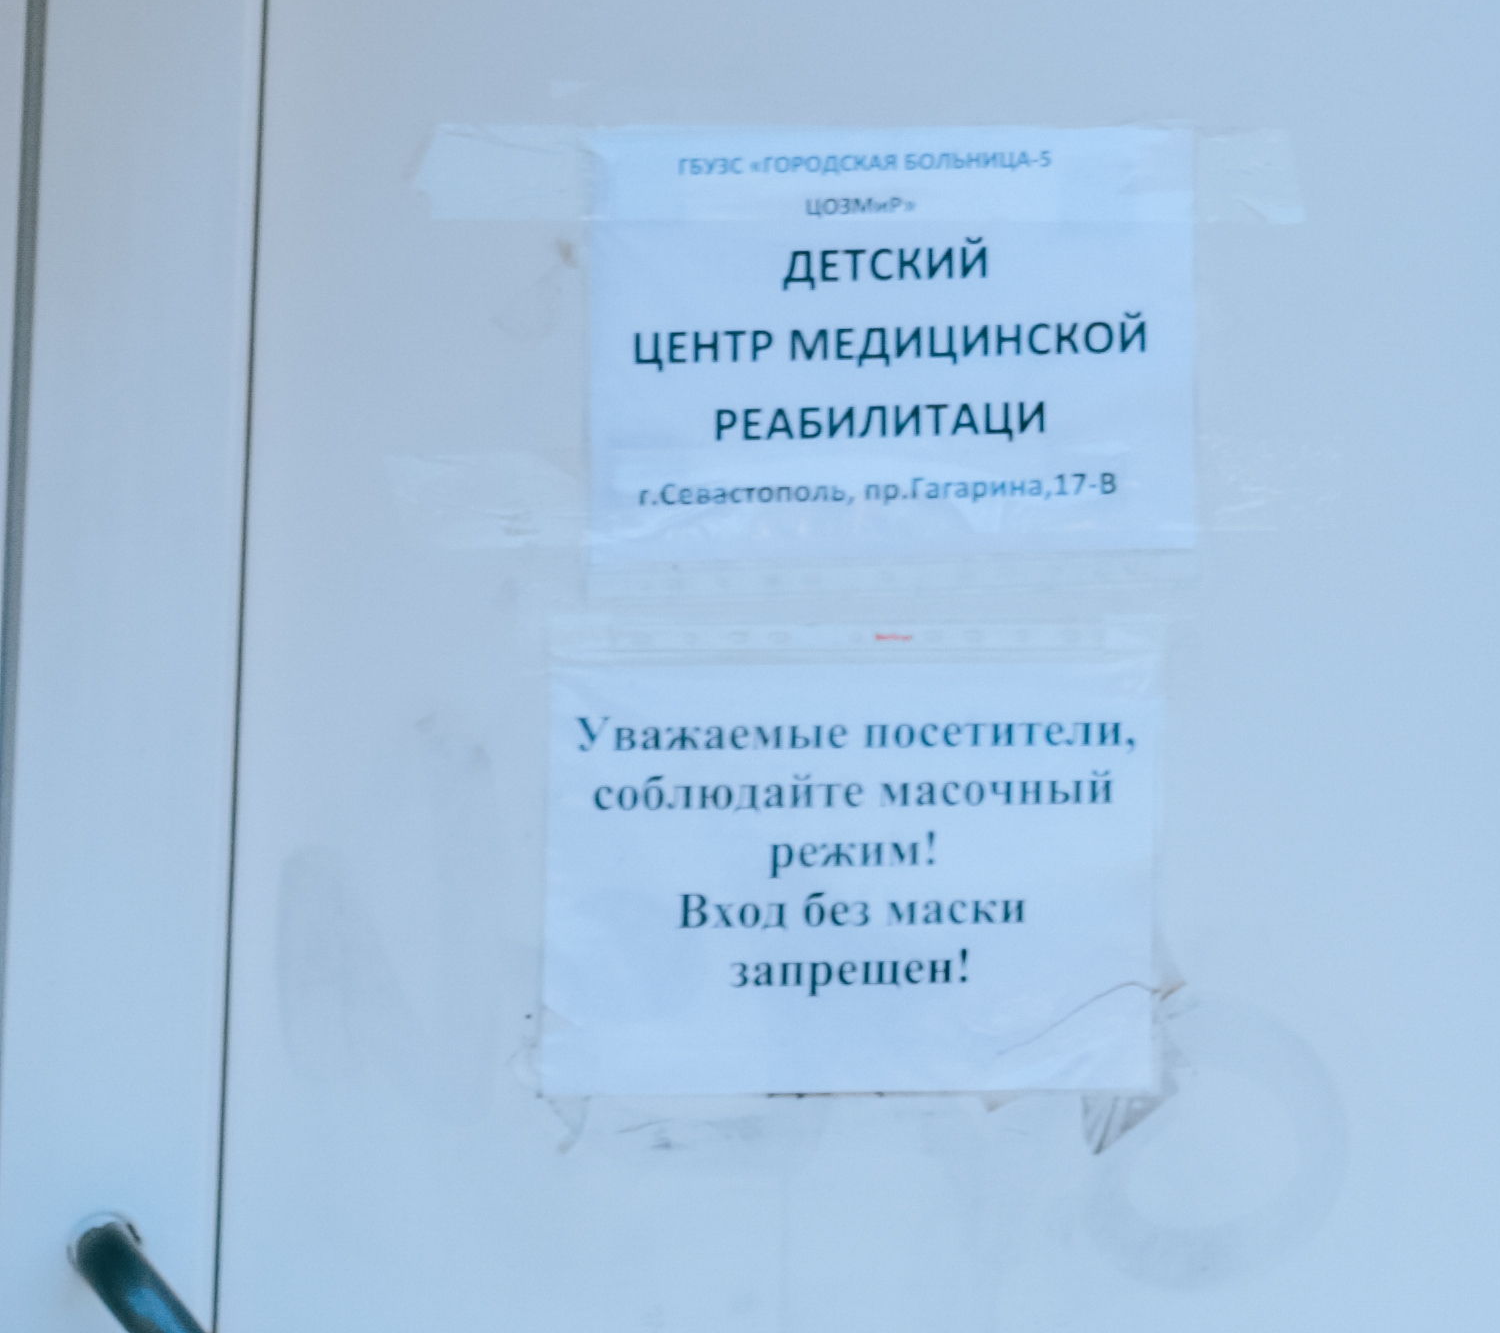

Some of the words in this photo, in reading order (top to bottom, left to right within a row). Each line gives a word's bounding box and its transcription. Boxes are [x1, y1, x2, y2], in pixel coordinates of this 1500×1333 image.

[677, 156, 743, 176] ГБУЗС
[750, 153, 898, 175] «ГОРОДСКАЯ
[904, 149, 1052, 171] БОЛЬНИЦА-5
[782, 237, 988, 291] ДЕТСКИЙ
[634, 329, 774, 372] ЦЕНТР
[790, 312, 1147, 368] МЕДИЦИНСКОЙ
[715, 401, 1045, 441] РЕАБИЛИТАЦИ
[575, 715, 849, 753] Уважаемые
[864, 719, 1137, 754] посетители,
[592, 773, 864, 813] соблюдайте
[881, 770, 1113, 808] масочный
[770, 830, 936, 879] режим!
[679, 893, 787, 931] Вход
[803, 891, 870, 927] без
[887, 897, 1025, 926] маски
[730, 947, 969, 997] запрещен!
